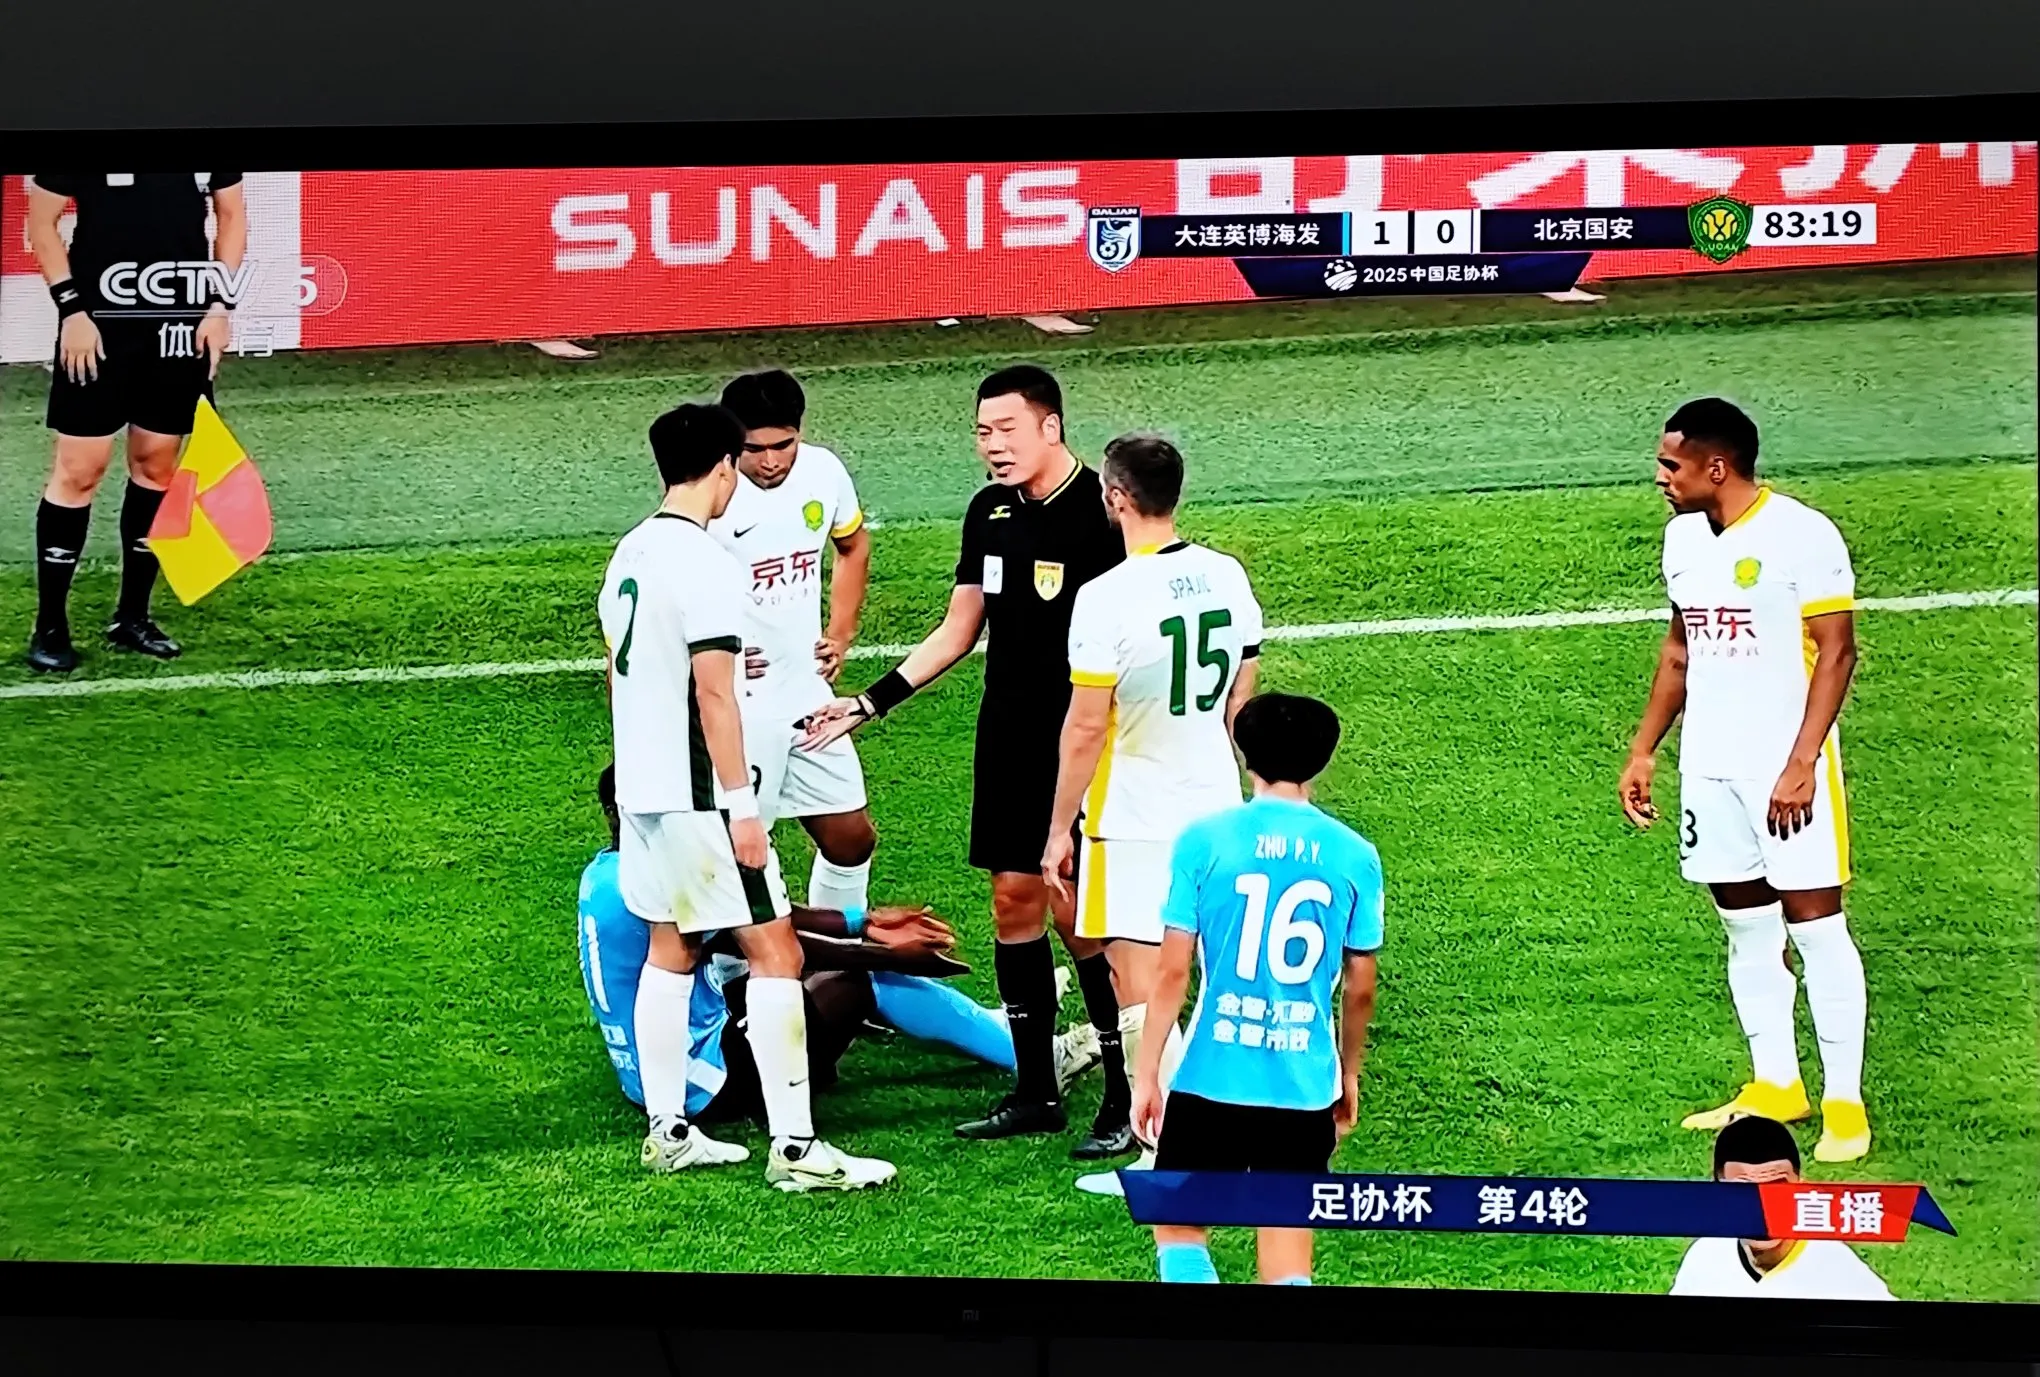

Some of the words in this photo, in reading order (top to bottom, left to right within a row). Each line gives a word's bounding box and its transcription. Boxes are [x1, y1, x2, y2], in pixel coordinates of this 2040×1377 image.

[550, 167, 1086, 272] SUNAIS
[1091, 207, 1138, 216] DALIAN
[1174, 222, 1321, 247] 大连英博海发
[1373, 221, 1390, 245] 1
[1436, 219, 1455, 244] 0
[1533, 216, 1634, 241] 北京国安
[1764, 209, 1863, 239] 83:19
[99, 261, 258, 305] CCTV
[751, 549, 819, 592] 京东
[1683, 606, 1758, 641] 京东
[1159, 608, 1232, 716] 15
[1254, 834, 1288, 861] ZHU
[1235, 873, 1333, 985] 16
[1308, 1182, 1433, 1223] 足协杯
[1477, 1185, 1588, 1227] 第4轮
[1792, 1189, 1885, 1236] 直播
